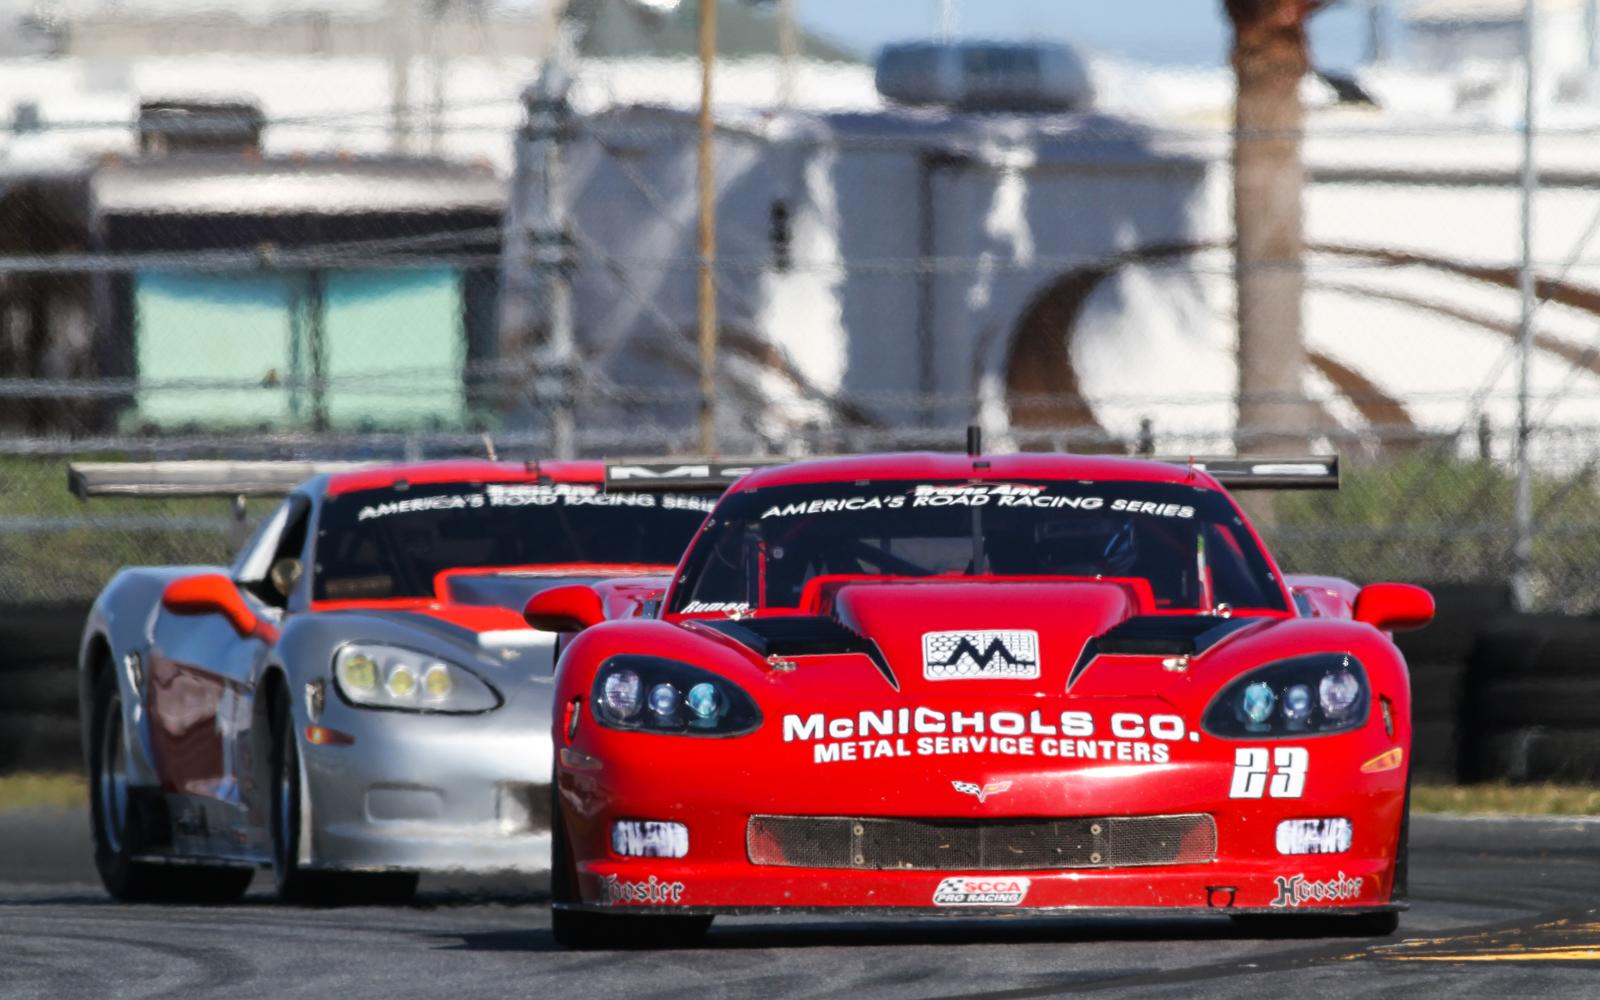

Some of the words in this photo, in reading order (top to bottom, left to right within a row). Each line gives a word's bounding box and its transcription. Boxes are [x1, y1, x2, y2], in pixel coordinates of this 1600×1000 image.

[358, 494, 484, 521] AMERICA'S
[490, 495, 558, 506] ROAD
[564, 493, 656, 508] RACING
[760, 495, 906, 520] AMERICA'S
[912, 495, 991, 508] ROAD
[998, 495, 1104, 510] RACING
[1110, 498, 1197, 520] SERIES
[1110, 712, 1201, 743] CO.
[813, 738, 912, 764] METAL
[917, 736, 1034, 756] SERVICE
[1041, 737, 1171, 764] CENTERS
[1228, 747, 1309, 799] 23
[936, 894, 965, 903] PRO
[967, 894, 1019, 903] RACING
[964, 882, 1021, 893] SCCA
[1269, 870, 1364, 907] Hoosier
